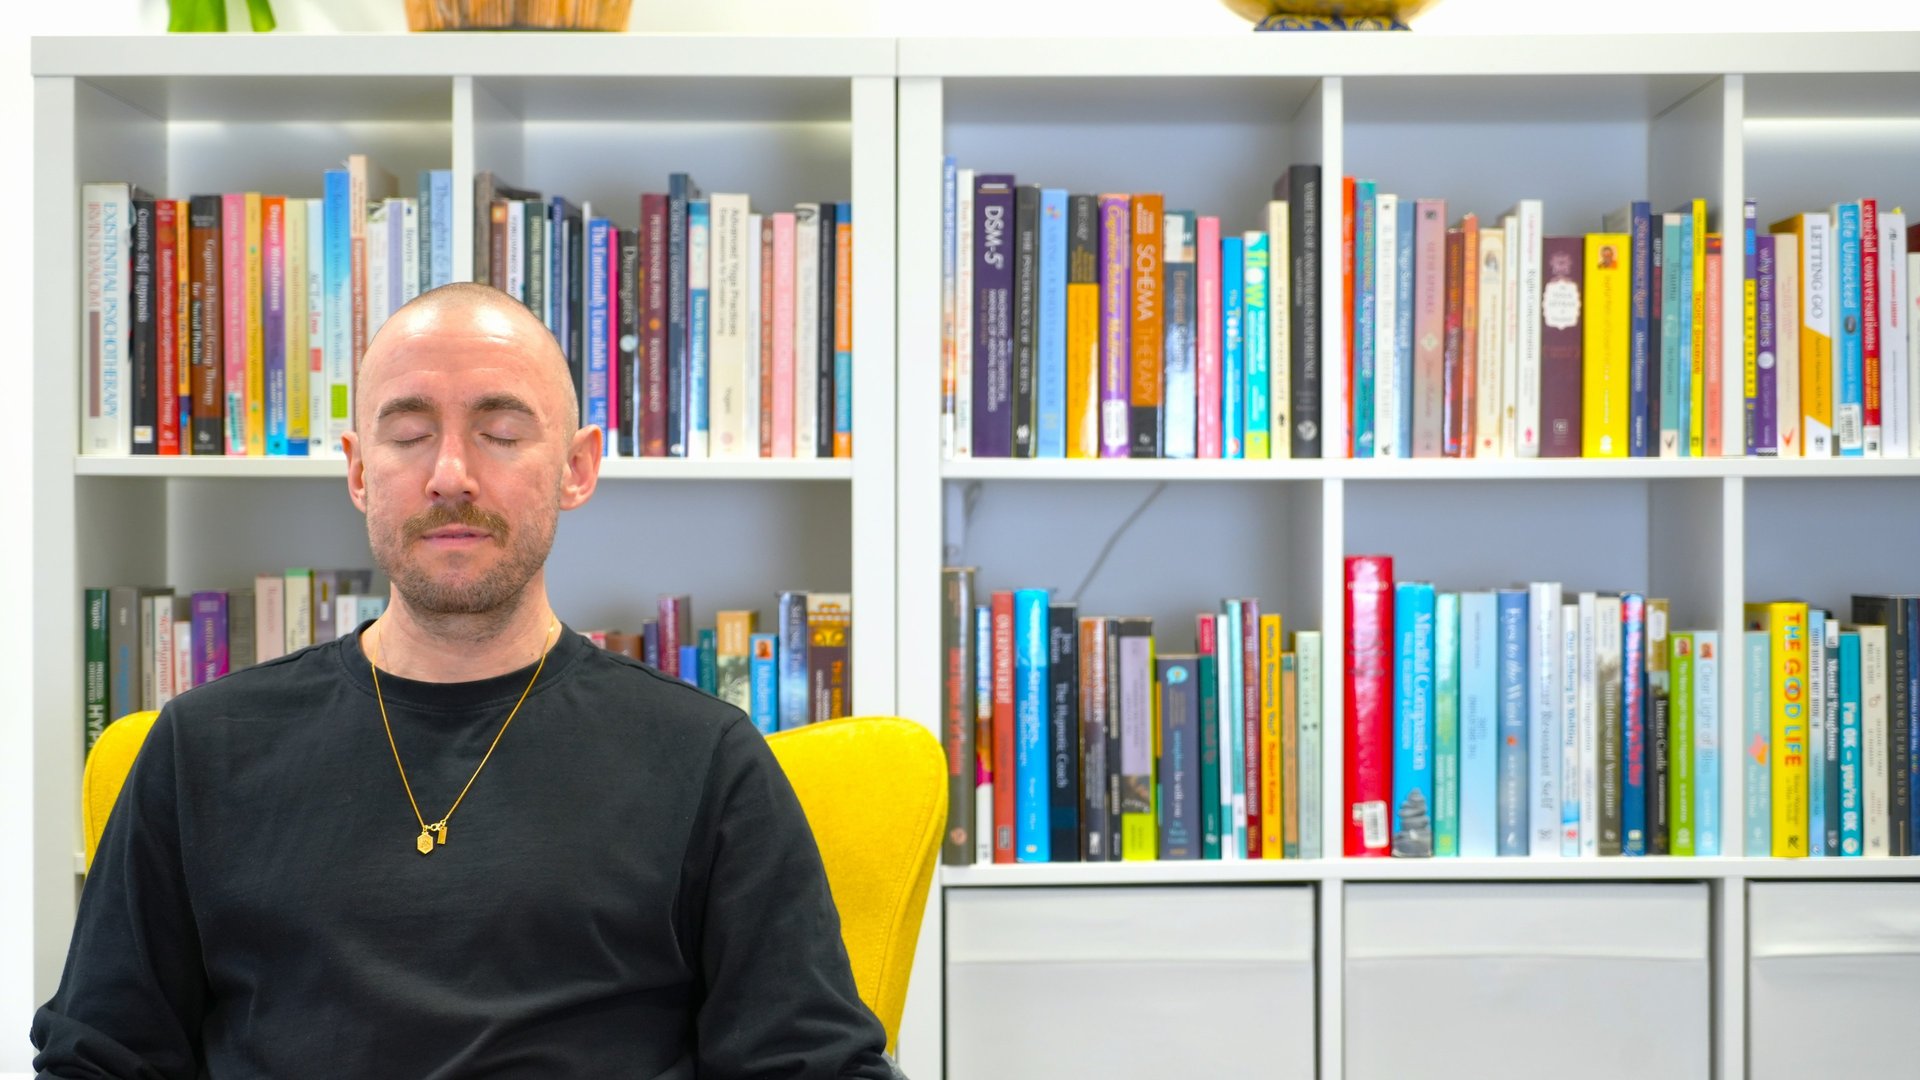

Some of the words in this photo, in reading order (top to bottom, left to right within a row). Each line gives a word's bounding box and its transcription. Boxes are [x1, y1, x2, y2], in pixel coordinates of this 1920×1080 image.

[1842, 211, 1856, 238] Life
[1136, 244, 1154, 320] SCHEMA
[1758, 248, 1772, 272] why
[1810, 225, 1823, 290] LETTING
[1842, 241, 1856, 308] Unlocked
[1760, 275, 1772, 299] love
[1810, 294, 1823, 319] GO
[1760, 302, 1772, 346] matters
[1138, 327, 1154, 404] THERAPY
[1414, 612, 1431, 673] Mindful
[1786, 613, 1800, 652] THE
[1786, 659, 1800, 718] GOOD
[1411, 674, 1431, 770] Compassion
[1786, 726, 1800, 766] LIFE
